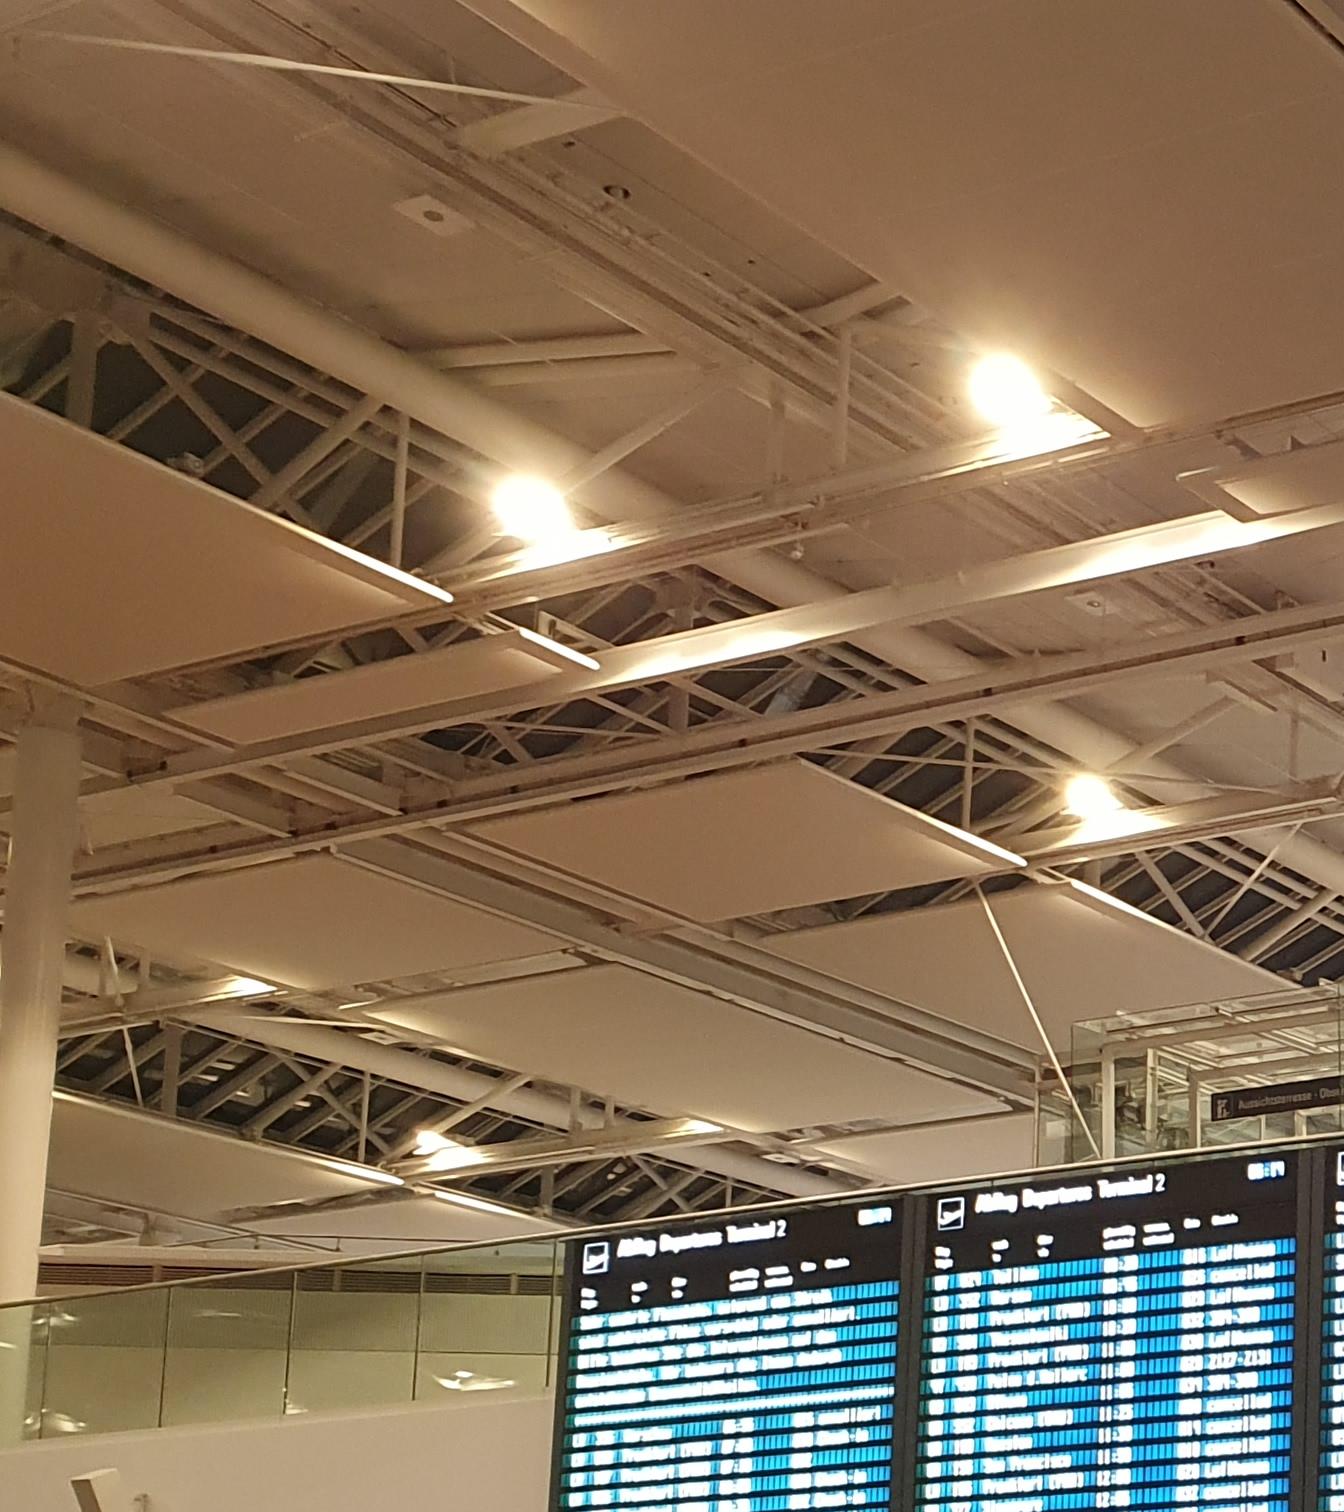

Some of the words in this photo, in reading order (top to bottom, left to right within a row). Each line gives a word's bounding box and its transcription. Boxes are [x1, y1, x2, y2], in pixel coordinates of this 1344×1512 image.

[1098, 1175, 1152, 1197] Terminal
[1156, 1174, 1164, 1191] 2
[777, 1220, 785, 1236] 2
